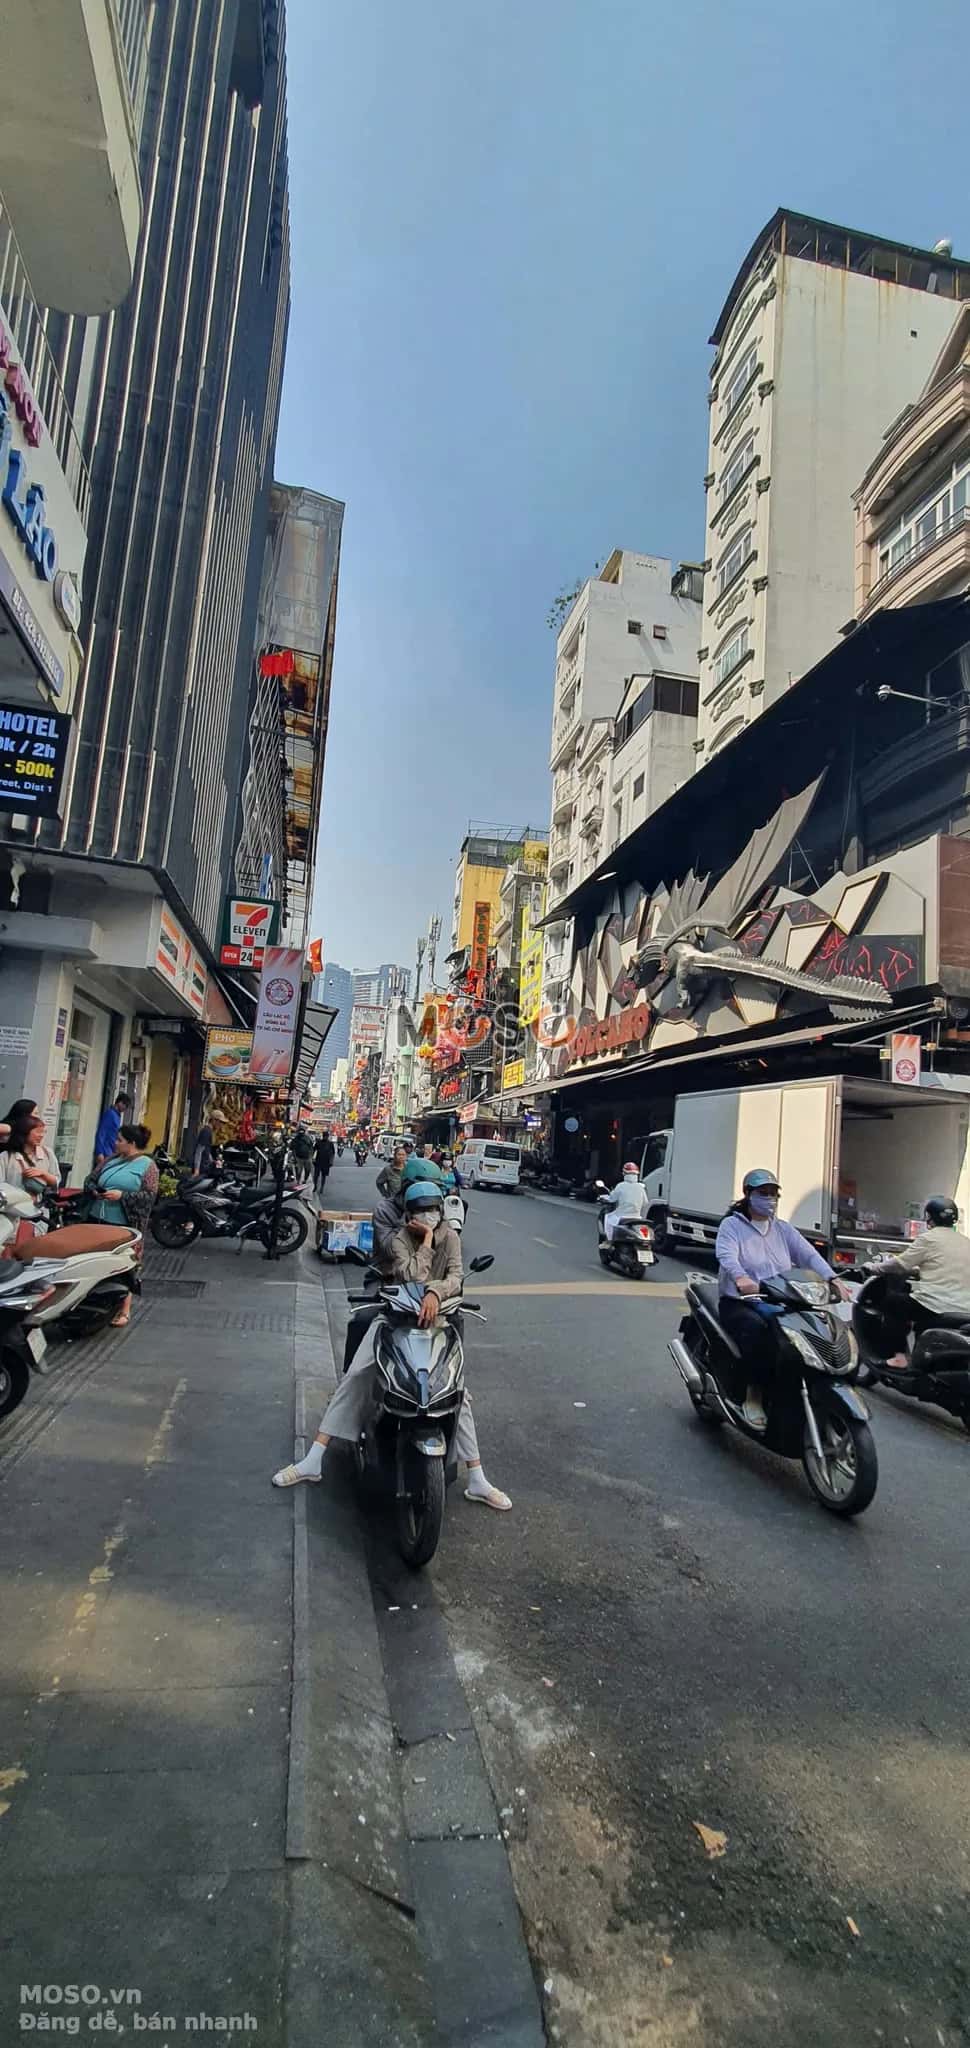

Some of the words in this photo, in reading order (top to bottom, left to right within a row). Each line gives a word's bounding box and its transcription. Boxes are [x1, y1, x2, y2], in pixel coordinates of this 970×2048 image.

[0, 710, 59, 738] HOTEL
[32, 742, 56, 759] 2h
[15, 760, 55, 778] 500k
[235, 904, 268, 926] 7
[241, 951, 252, 962] 24
